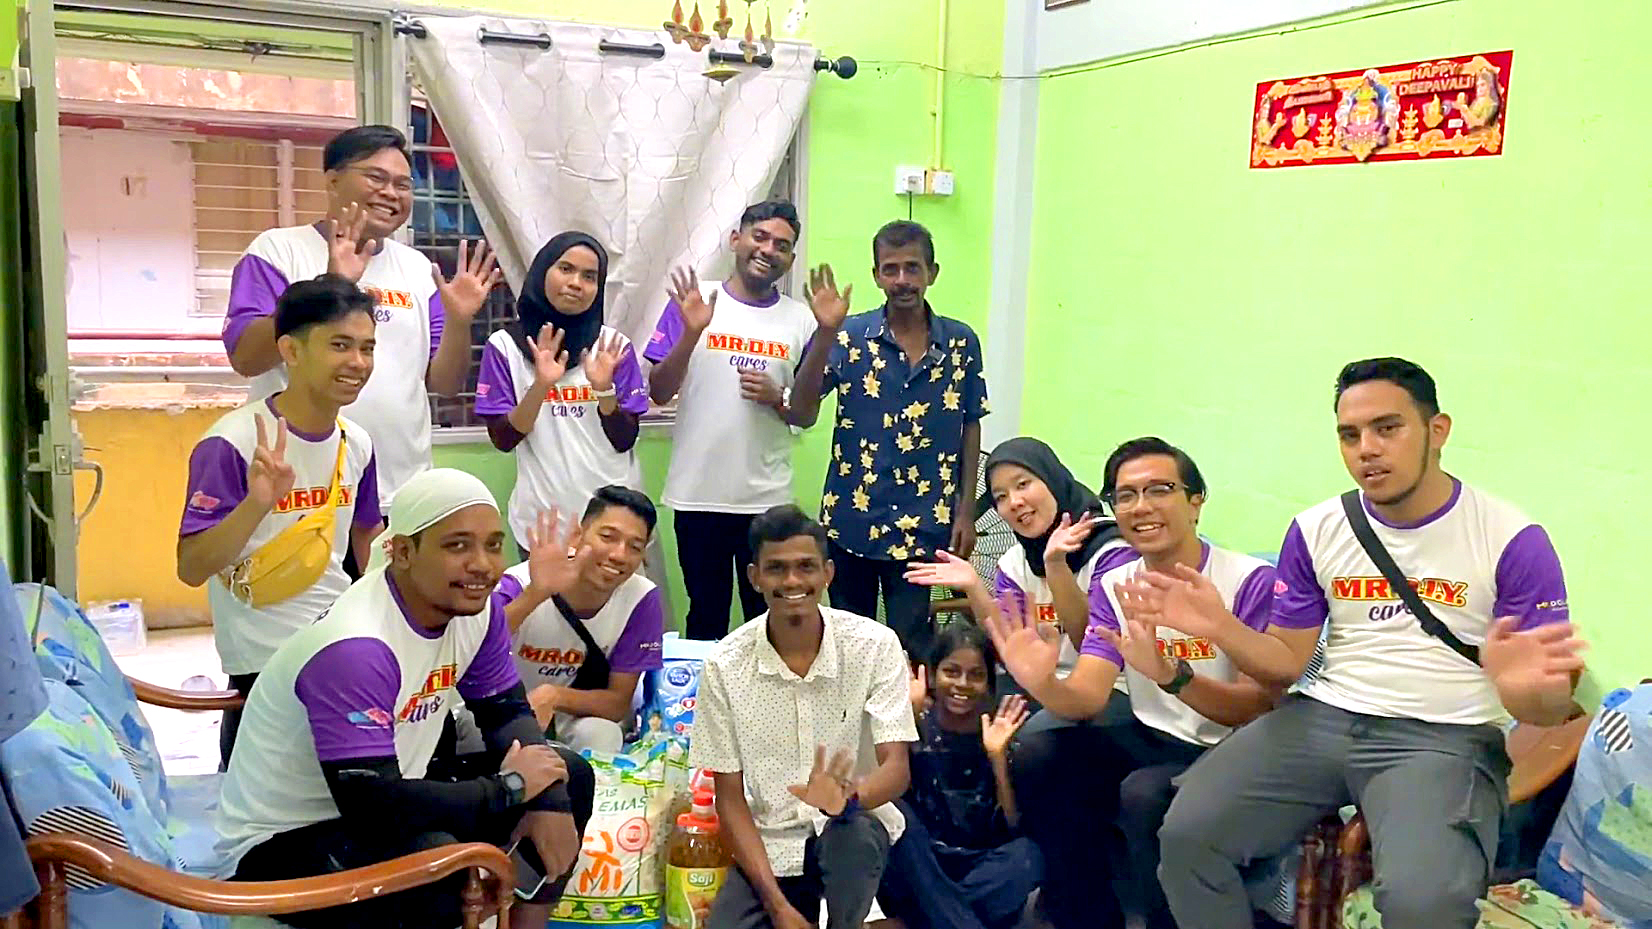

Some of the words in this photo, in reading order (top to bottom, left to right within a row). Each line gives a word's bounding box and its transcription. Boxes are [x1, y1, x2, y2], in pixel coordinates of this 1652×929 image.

[1411, 64, 1457, 80] HAPPY
[729, 354, 768, 371] cares
[598, 796, 649, 812] EMAS
[689, 872, 714, 886] Saji
